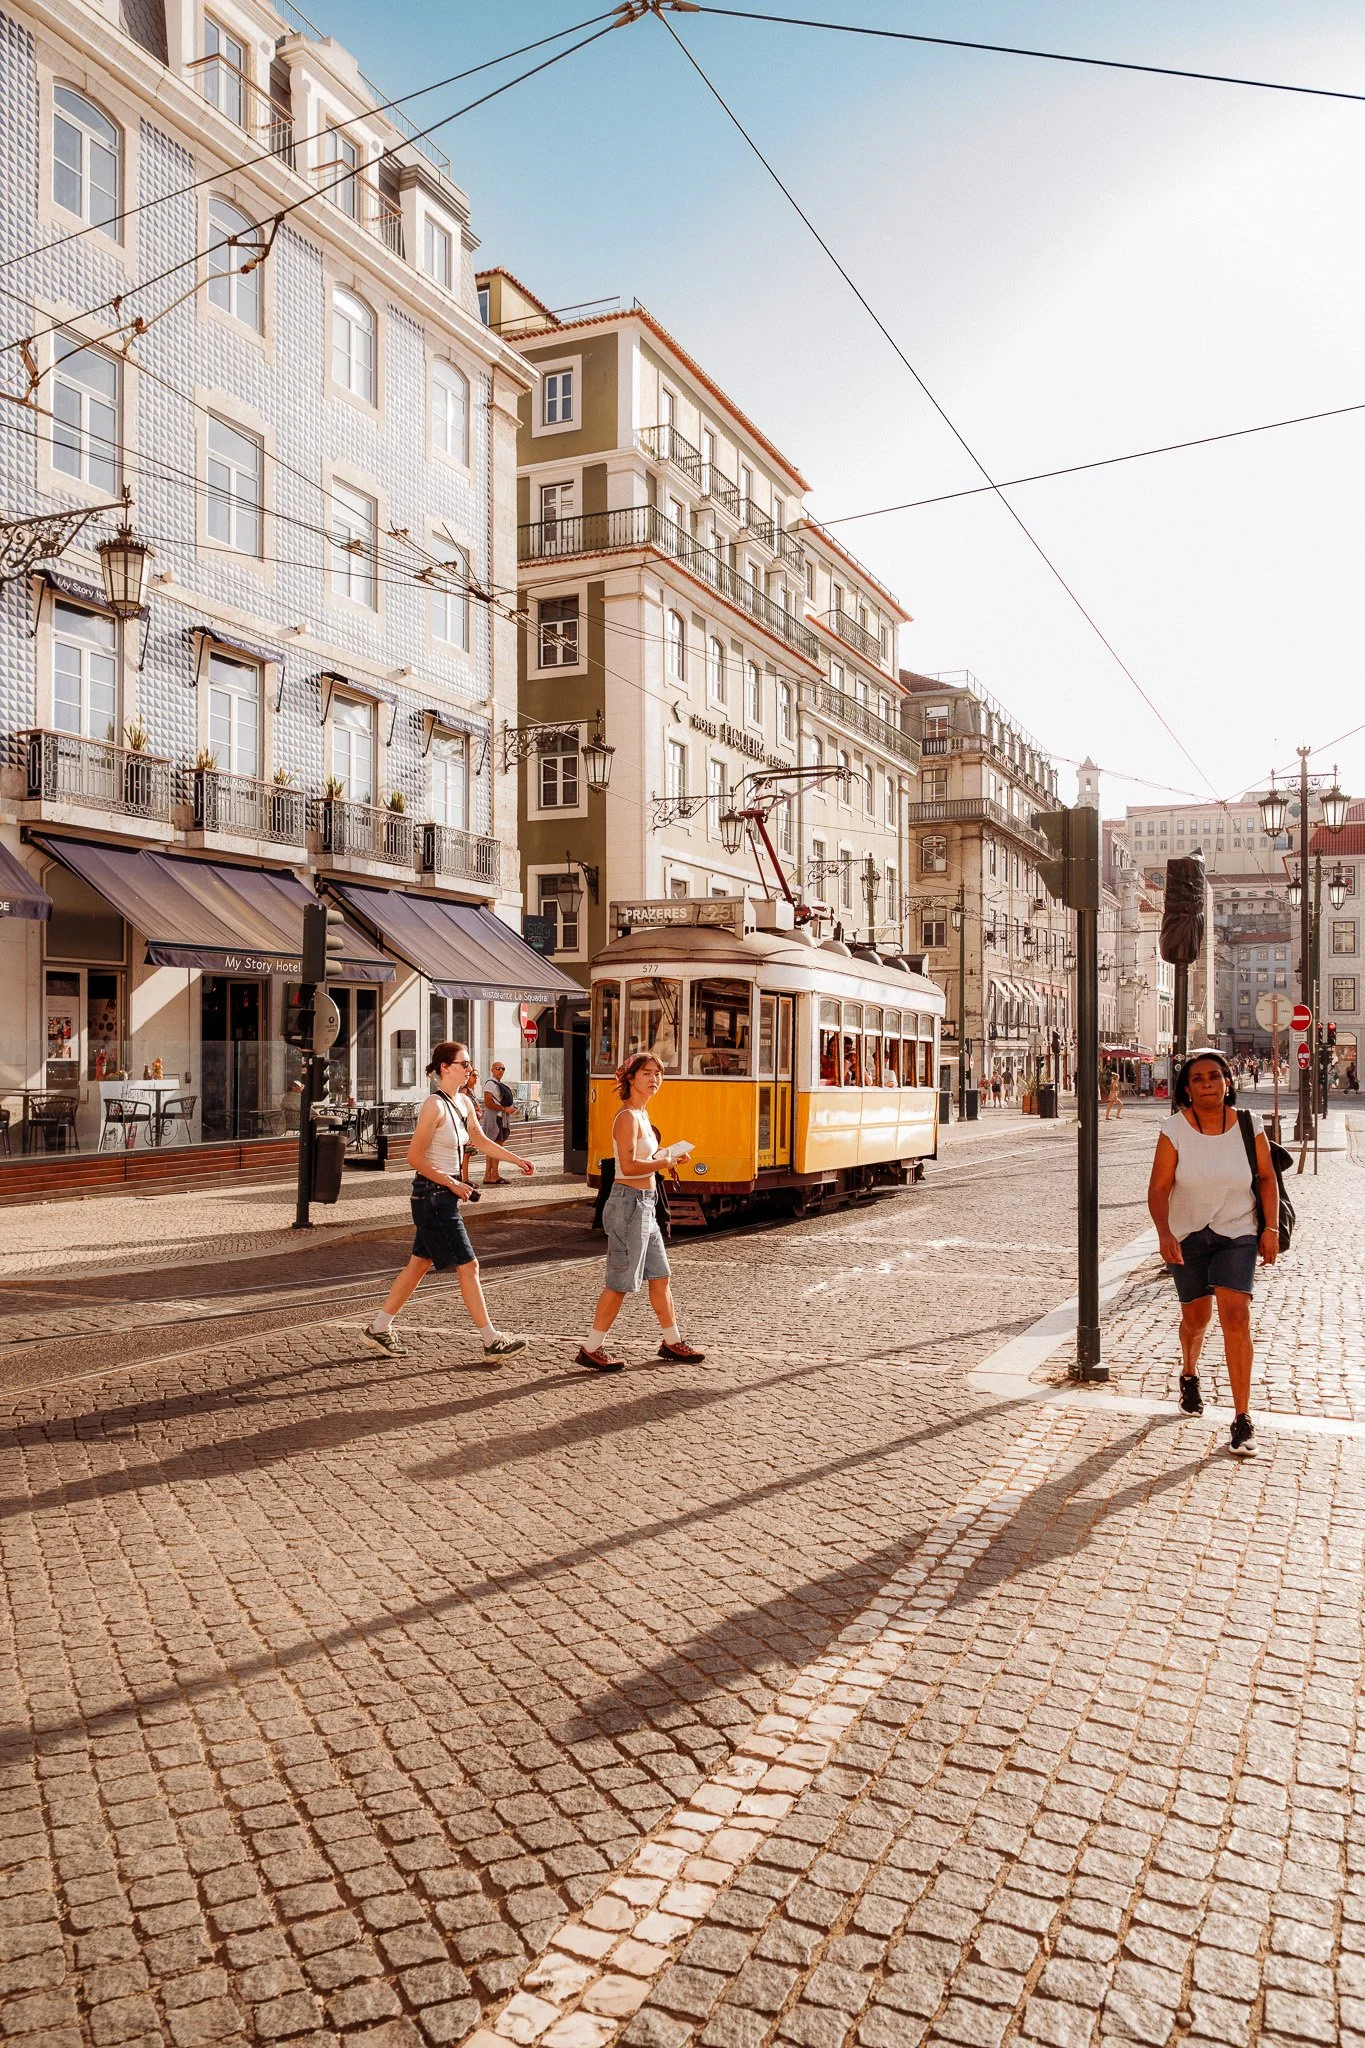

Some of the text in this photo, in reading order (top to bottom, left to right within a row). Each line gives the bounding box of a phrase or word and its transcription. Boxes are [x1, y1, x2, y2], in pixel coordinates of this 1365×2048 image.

[57, 578, 71, 589] My
[72, 582, 94, 598] Story
[625, 907, 688, 920] PRAZERES
[225, 956, 301, 973] My Story Hotel
[642, 965, 659, 973] 577
[514, 992, 523, 1001] La
[523, 992, 548, 1003] Squadra
